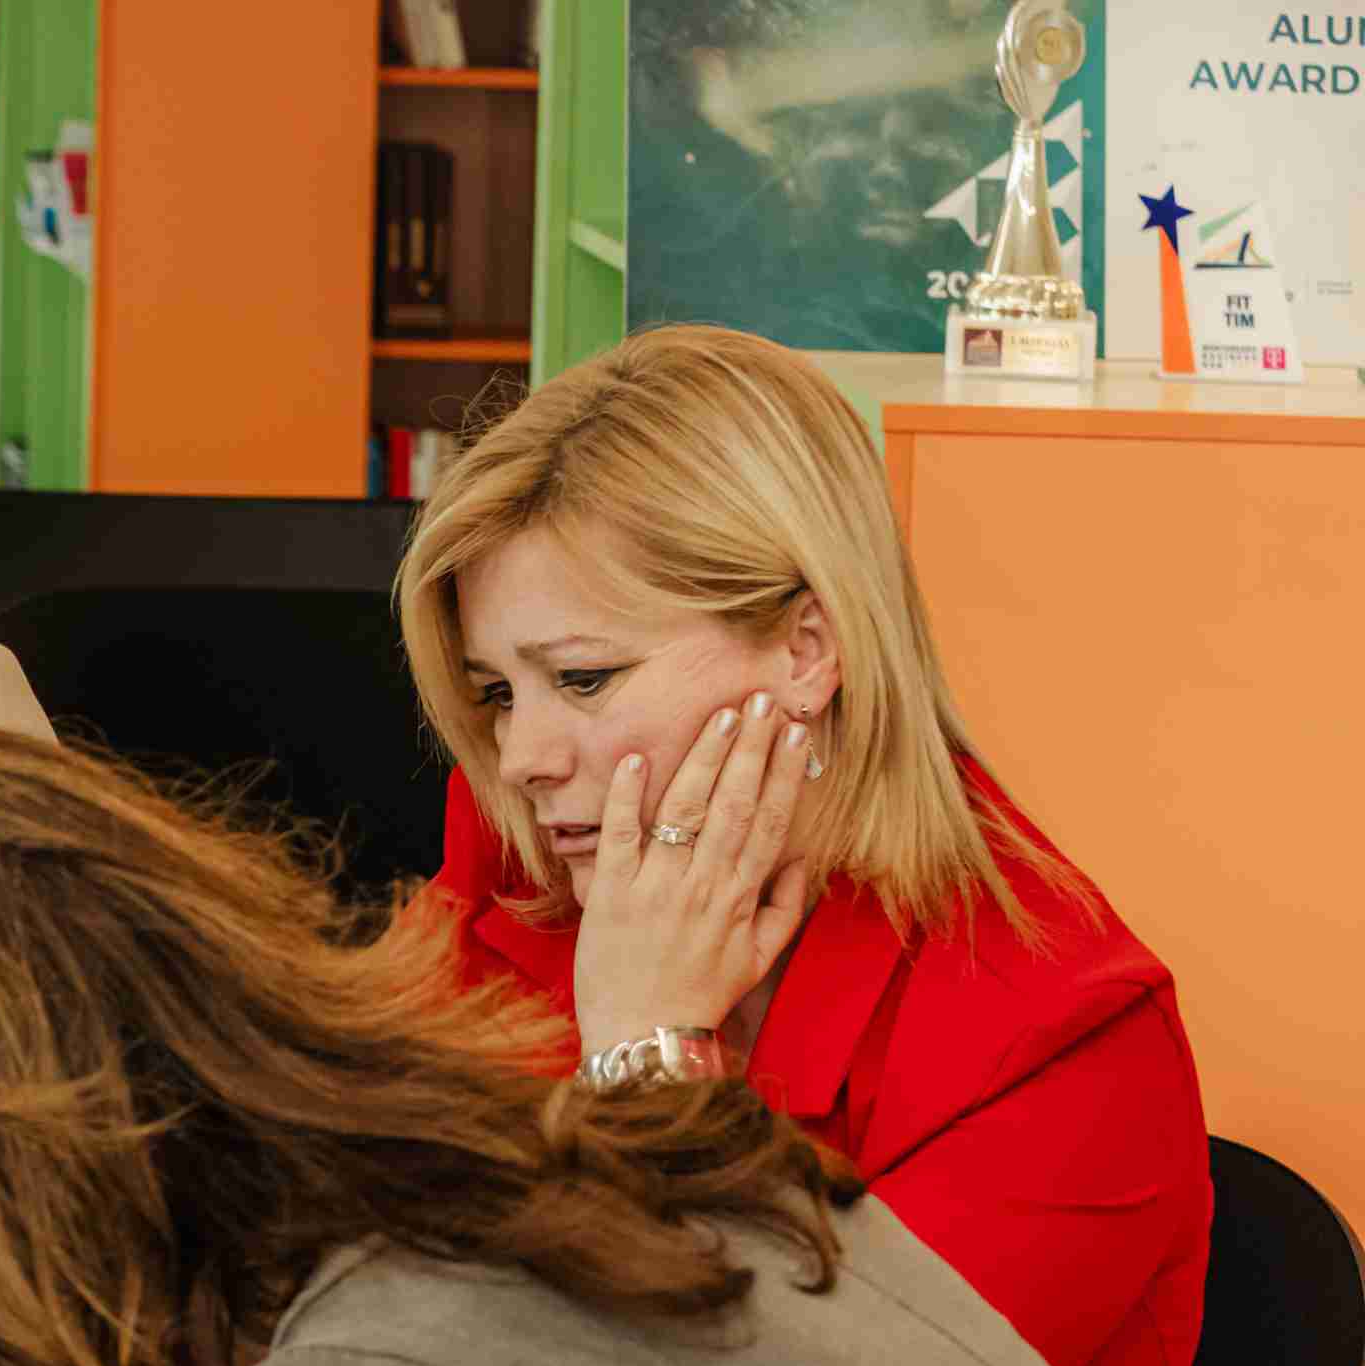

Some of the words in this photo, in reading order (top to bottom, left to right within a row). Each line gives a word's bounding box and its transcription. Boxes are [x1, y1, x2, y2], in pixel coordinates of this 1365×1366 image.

[1189, 60, 1360, 94] AWARD
[1226, 295, 1251, 310] FIT
[1225, 312, 1255, 328] TIM
